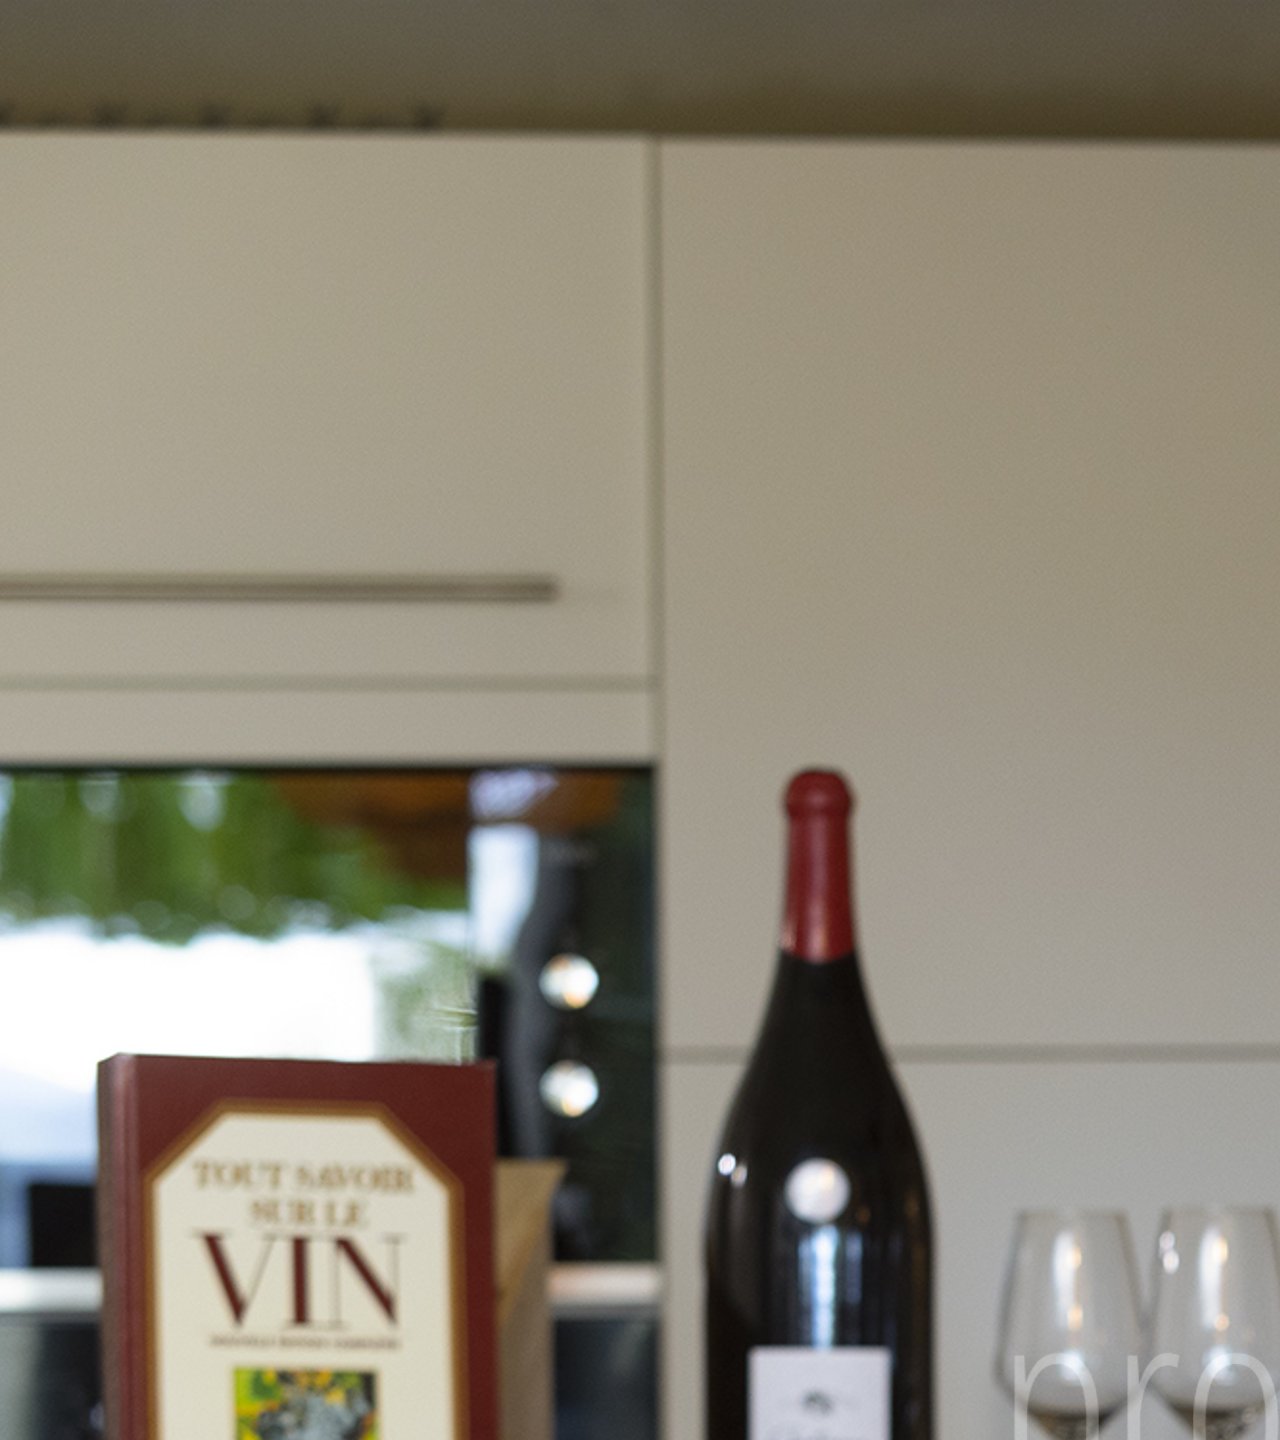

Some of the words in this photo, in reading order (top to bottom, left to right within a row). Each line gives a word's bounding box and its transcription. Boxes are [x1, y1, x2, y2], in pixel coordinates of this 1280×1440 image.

[194, 1160, 285, 1189] TOUT
[296, 1163, 414, 1192] SAVOIR
[324, 1200, 367, 1226] LE
[191, 1227, 407, 1329] VIN
